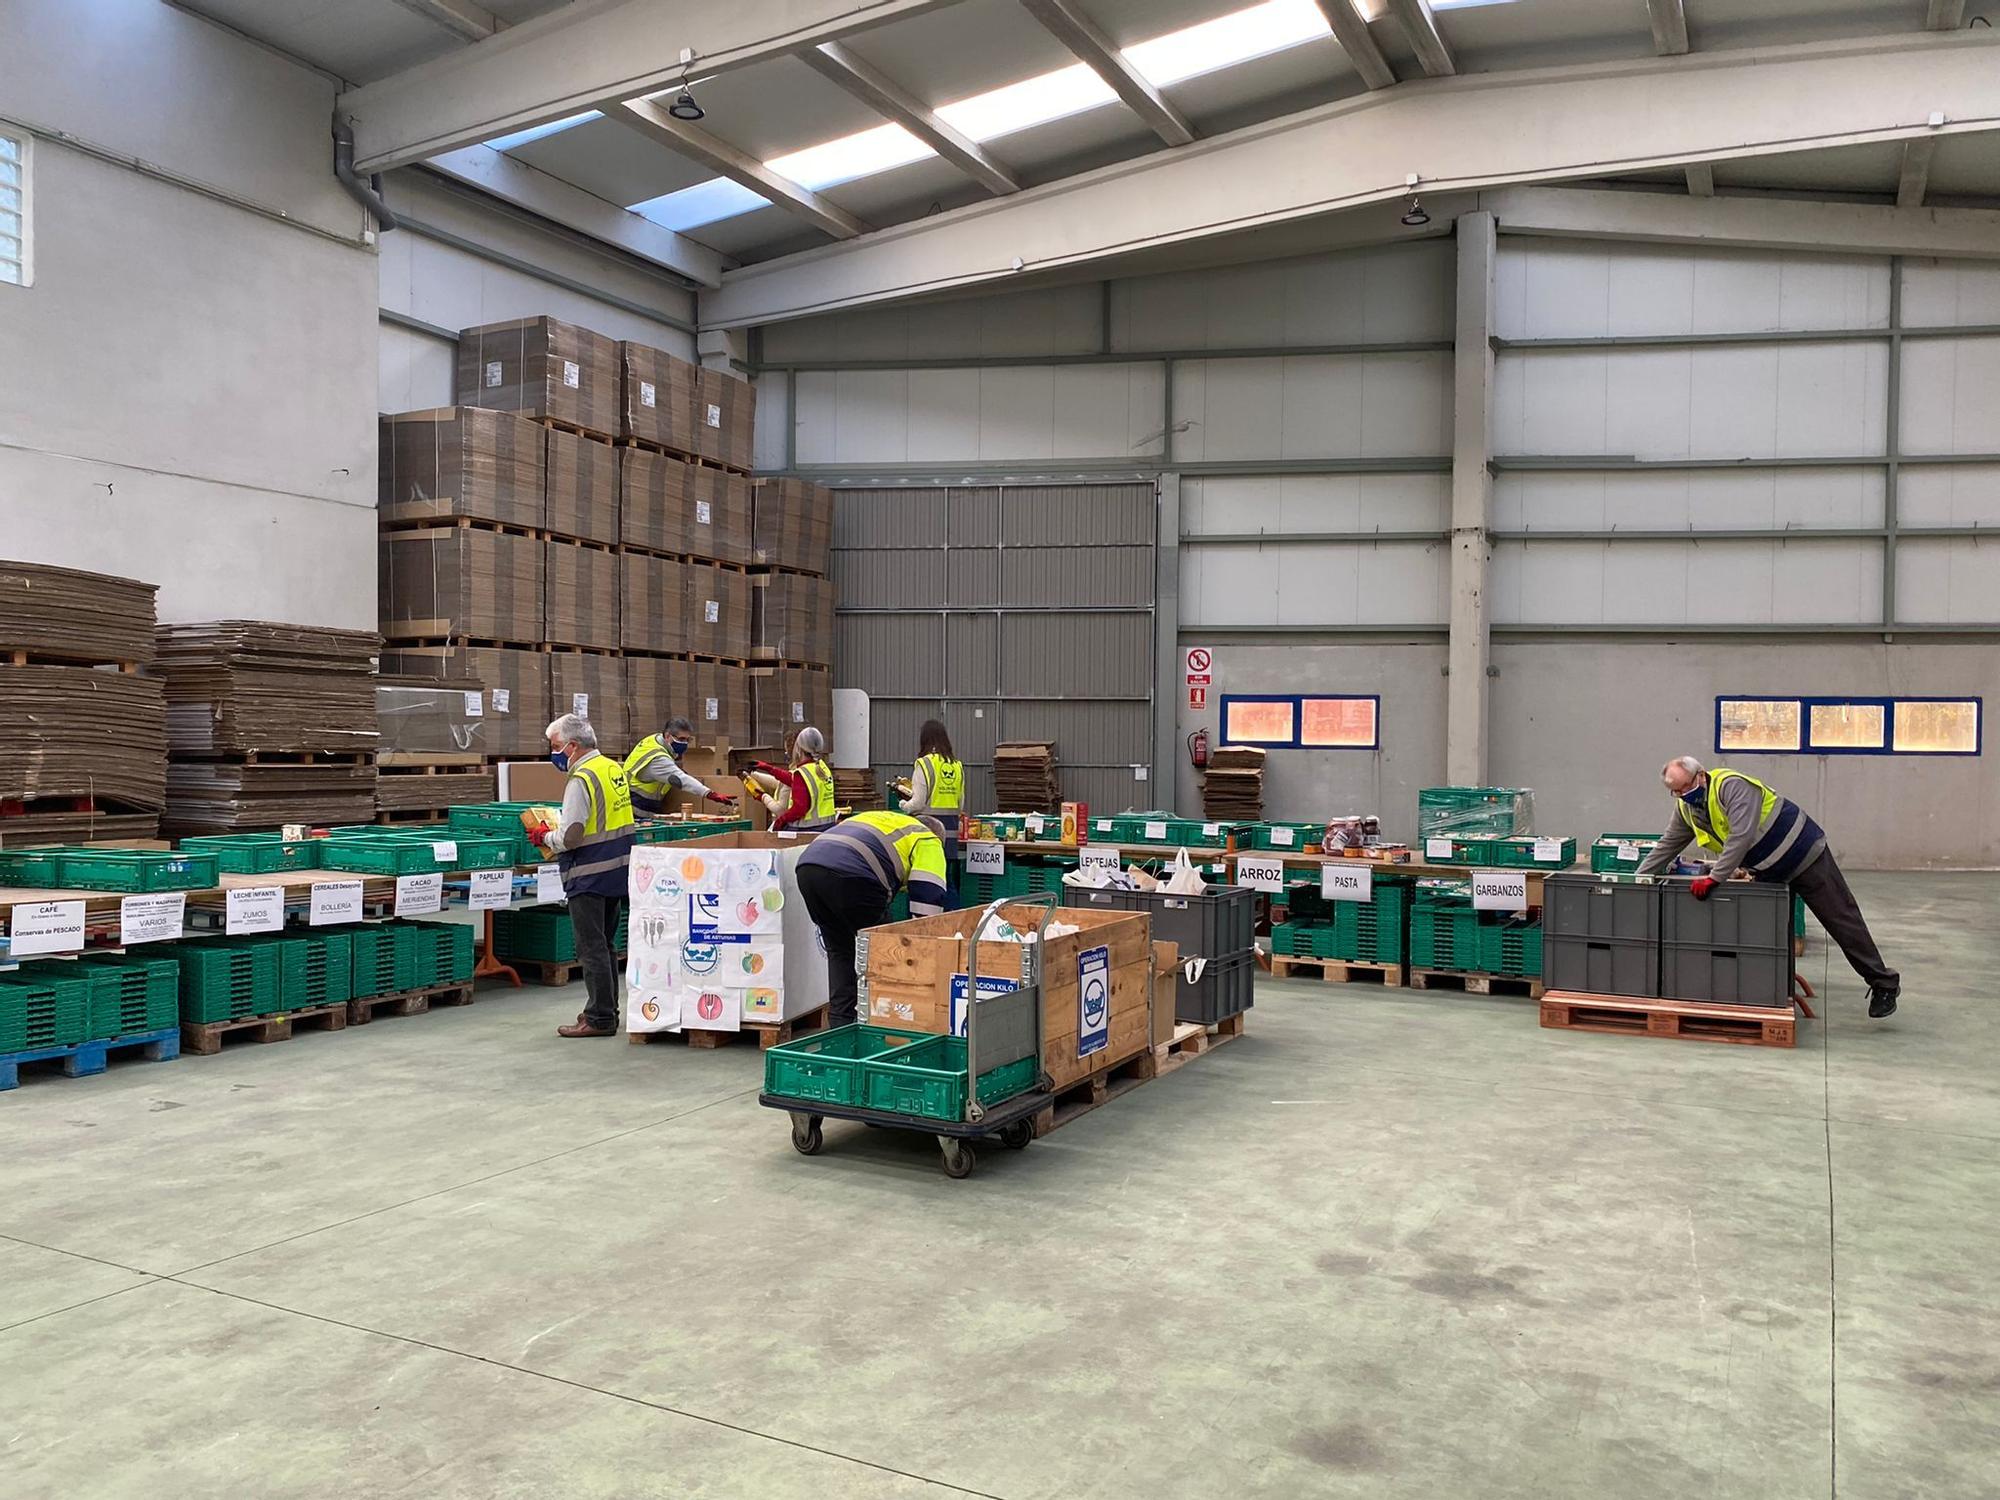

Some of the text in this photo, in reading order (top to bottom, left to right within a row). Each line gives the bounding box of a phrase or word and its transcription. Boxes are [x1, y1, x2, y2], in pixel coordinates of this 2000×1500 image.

[970, 849, 1001, 864] AZÚCAR
[1081, 856, 1118, 869] LENTEJAS
[479, 872, 504, 880] PAPILLAS
[1239, 867, 1281, 882] ARROZ
[410, 879, 432, 887] CACAO
[1334, 876, 1359, 889] PASTA
[1475, 884, 1524, 897] GARBANZOS
[39, 905, 58, 914] CAFÉ
[321, 901, 352, 910] BOLLERÍA
[242, 910, 268, 919] ZUMOS
[139, 917, 167, 927] VARIOS
[14, 929, 44, 937] Conservas
[53, 926, 81, 934] PESCADO
[955, 980, 1014, 993] OPEACION KILO
